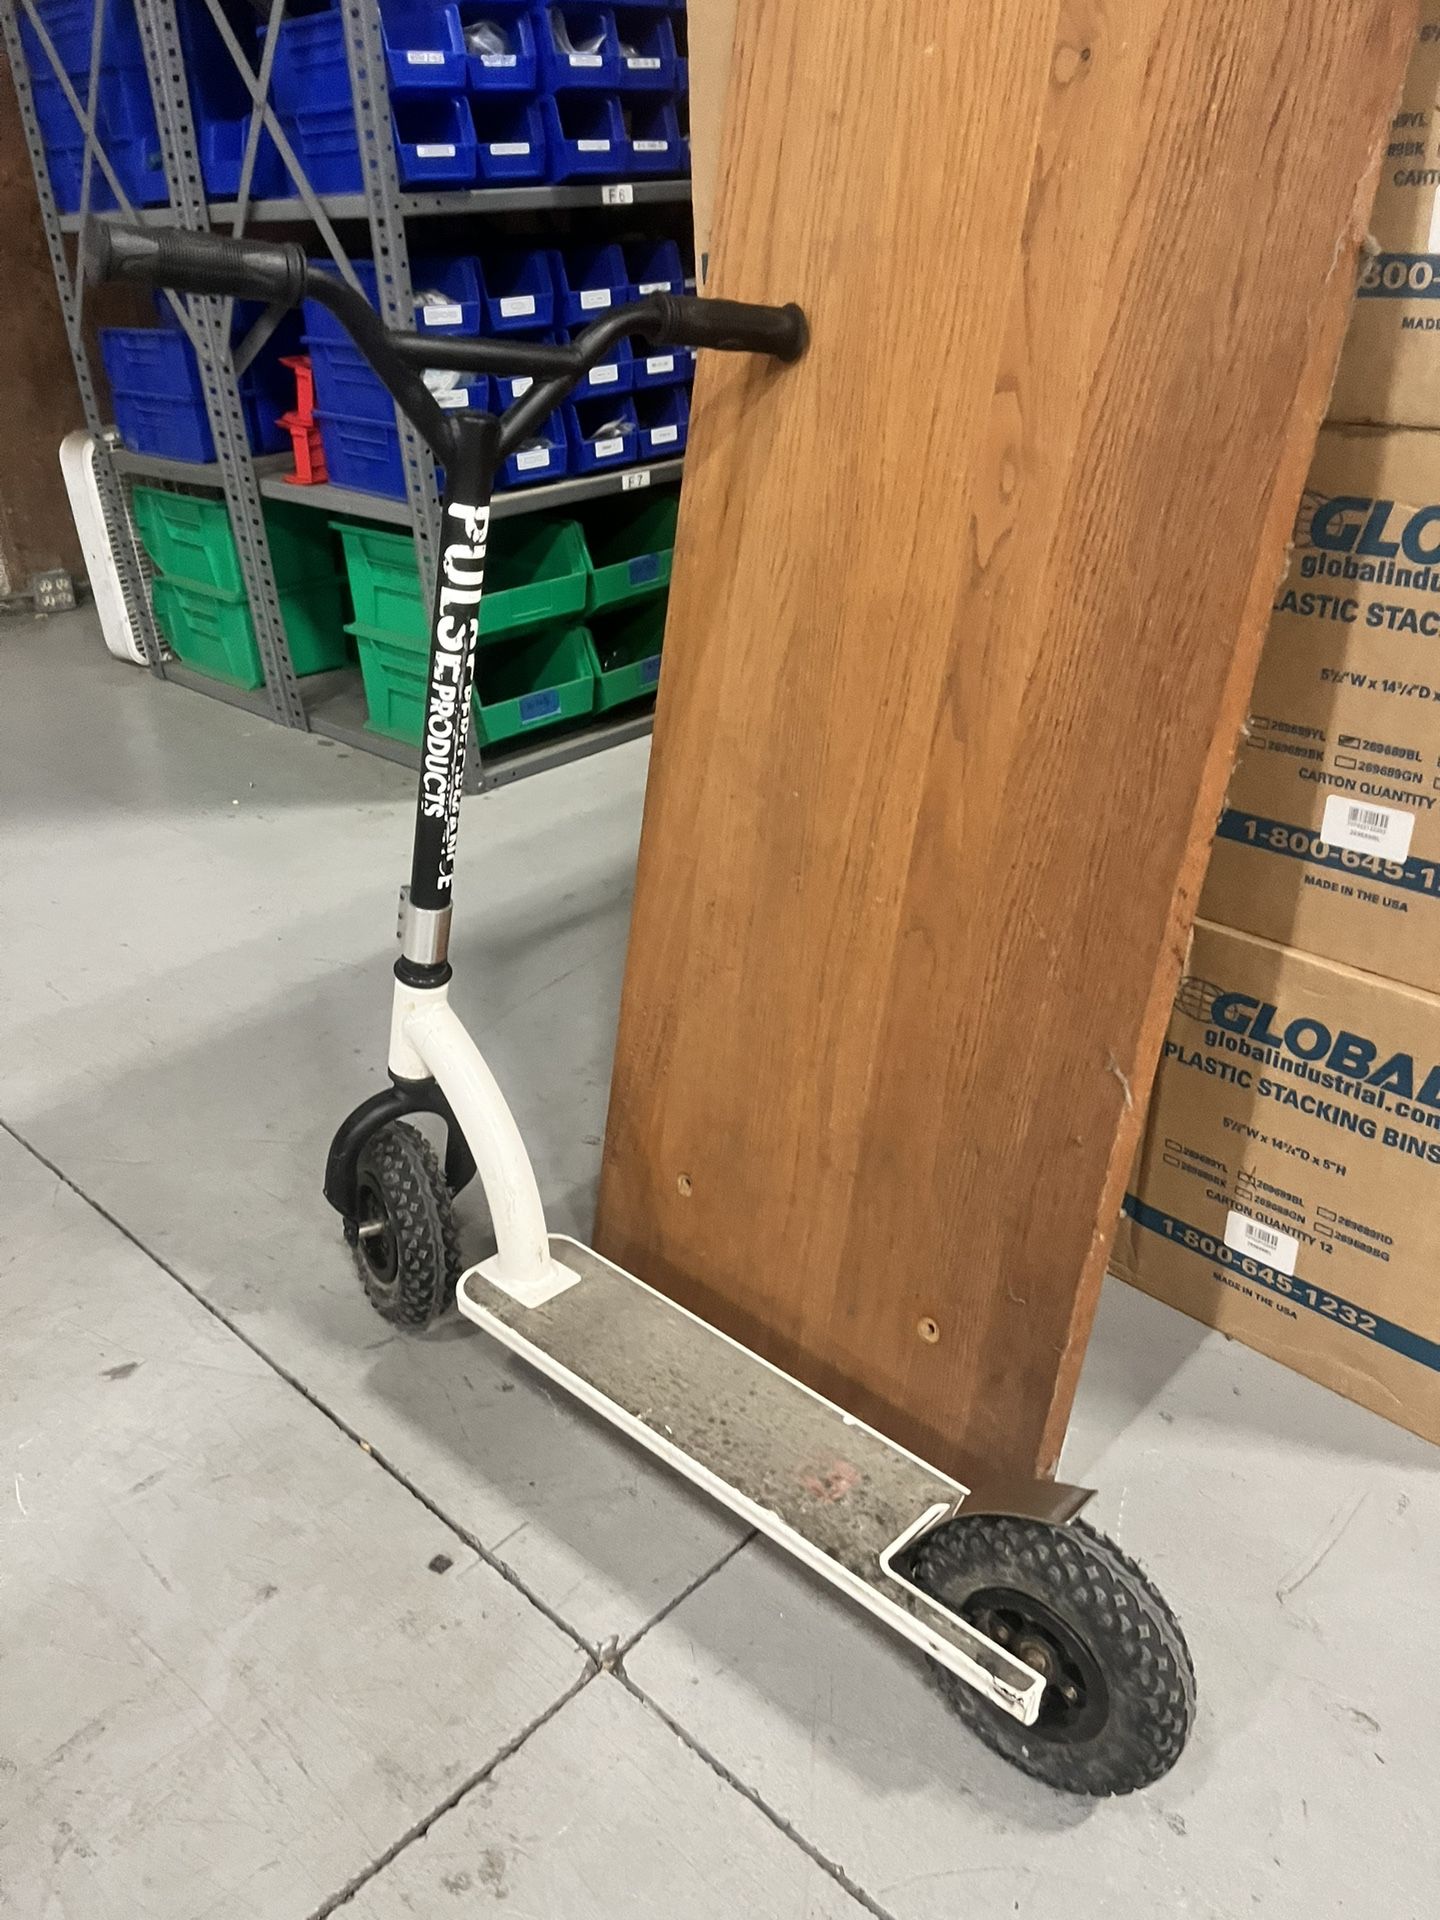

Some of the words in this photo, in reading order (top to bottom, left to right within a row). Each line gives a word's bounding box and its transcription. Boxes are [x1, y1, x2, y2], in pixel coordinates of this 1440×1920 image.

[1393, 170, 1440, 187] CART
[1273, 590, 1359, 623] ASTIC
[1365, 602, 1440, 636] STAC
[1368, 679, 1378, 690] x
[422, 681, 457, 818] PRODUCTS
[1299, 767, 1357, 790] CARTON
[1360, 782, 1437, 809] QUANTITY
[1244, 820, 1440, 890] 1-800-645-1
[1304, 874, 1339, 892] MADE
[1341, 885, 1353, 897] IN
[1357, 889, 1380, 905] THE
[1383, 897, 1408, 913] USA
[1210, 991, 1440, 1109] GLOBAL
[1163, 1040, 1253, 1089] PLASTIC
[1257, 1078, 1377, 1140] STACKING
[1383, 1127, 1440, 1165] BINS
[1206, 1188, 1253, 1216] CARTON
[1255, 1211, 1317, 1247] QUANTITY
[1320, 1241, 1334, 1255] 12
[1162, 1219, 1378, 1335] 1-800-645-1232
[1212, 1271, 1241, 1292] MADE
[1242, 1285, 1253, 1297] IN
[1255, 1291, 1274, 1308] THE
[1276, 1303, 1298, 1320] USA
